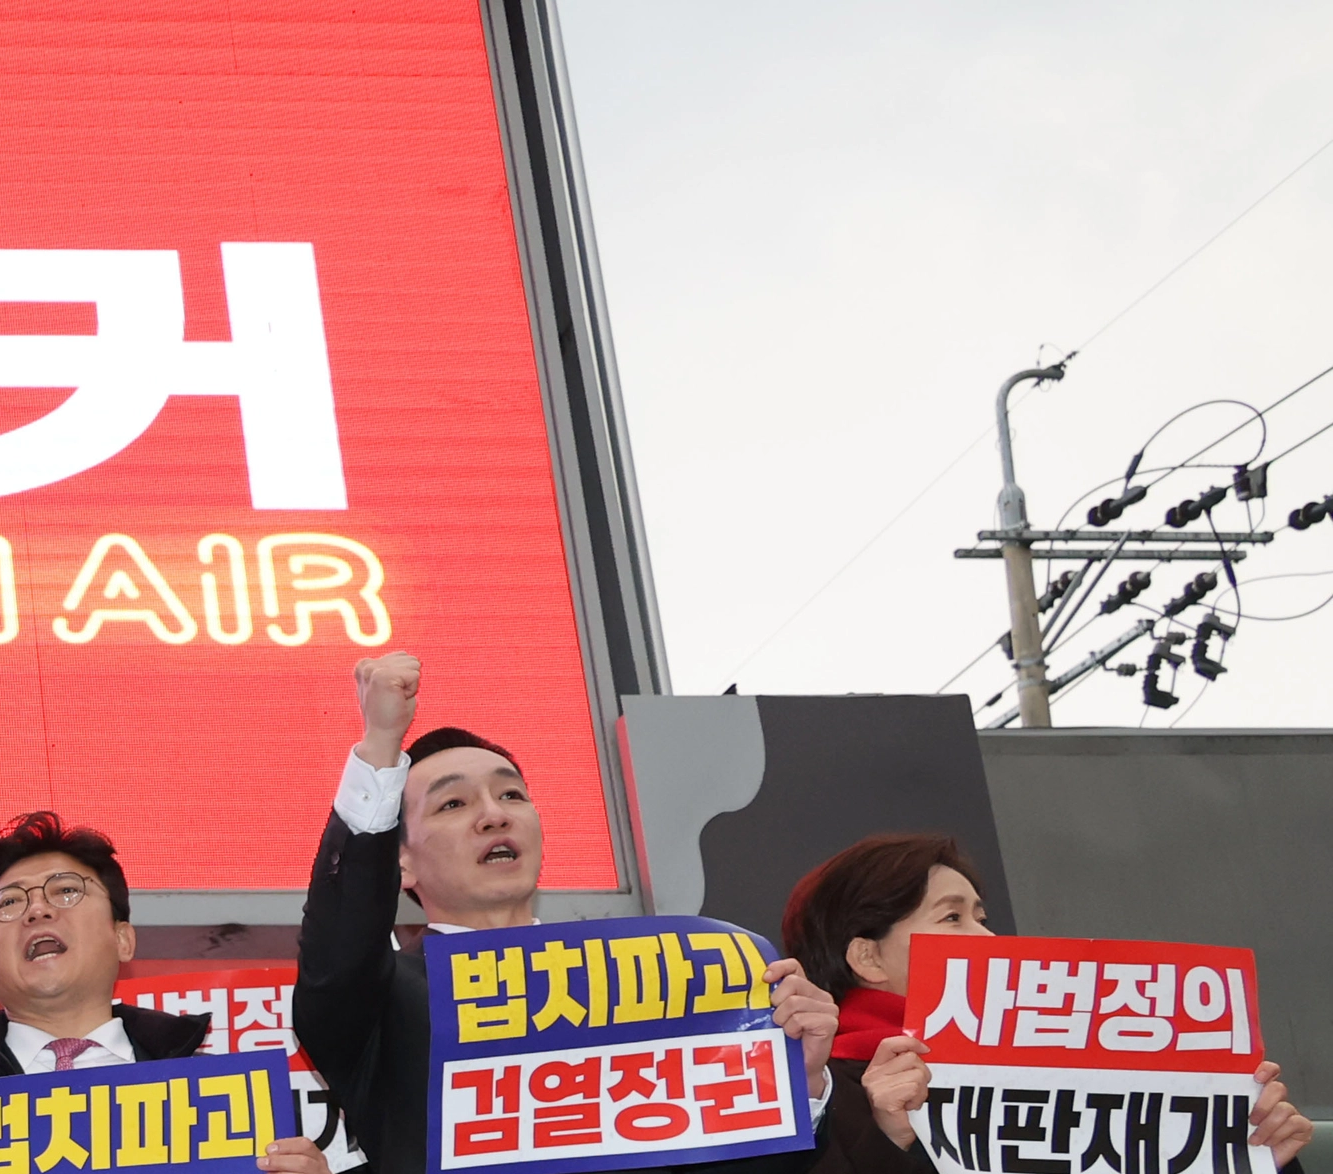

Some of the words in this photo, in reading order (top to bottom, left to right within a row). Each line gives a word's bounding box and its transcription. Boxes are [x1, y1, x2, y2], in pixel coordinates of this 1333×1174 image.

[52, 532, 392, 647] AIR
[450, 931, 772, 1044] 법치파괴
[924, 956, 1252, 1056] 사법정의
[452, 1040, 784, 1157] 검열정권
